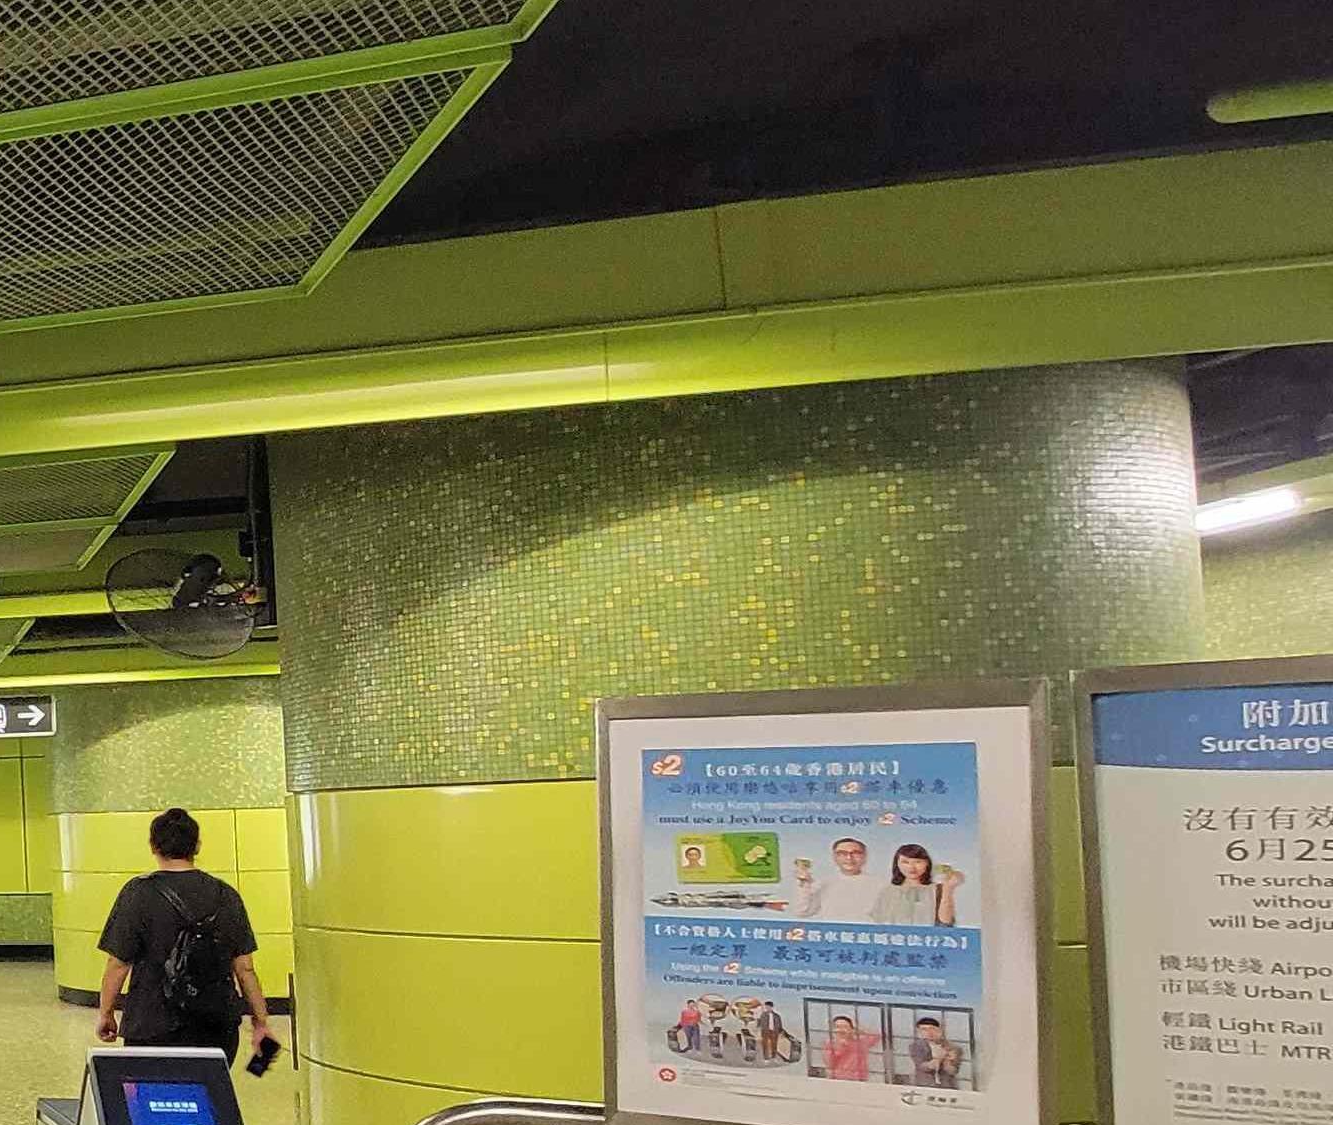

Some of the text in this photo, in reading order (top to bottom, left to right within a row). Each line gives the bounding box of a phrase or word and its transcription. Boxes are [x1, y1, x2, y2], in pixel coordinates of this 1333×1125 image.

[1242, 699, 1329, 729] 附加
[1200, 735, 1333, 754] Surcharge
[779, 815, 813, 824] Card
[817, 816, 831, 824] to
[835, 815, 871, 827] enjoy
[900, 816, 958, 825] Scheme
[1183, 806, 1333, 831] 沒有有效
[1215, 874, 1333, 888] The surcha
[1253, 895, 1333, 909] withou
[1208, 915, 1333, 934] will be adju
[1271, 962, 1333, 979] Airpo
[1244, 985, 1313, 1000] Urban
[1218, 1018, 1324, 1035] Light Rail
[1281, 1045, 1333, 1060] MTR
